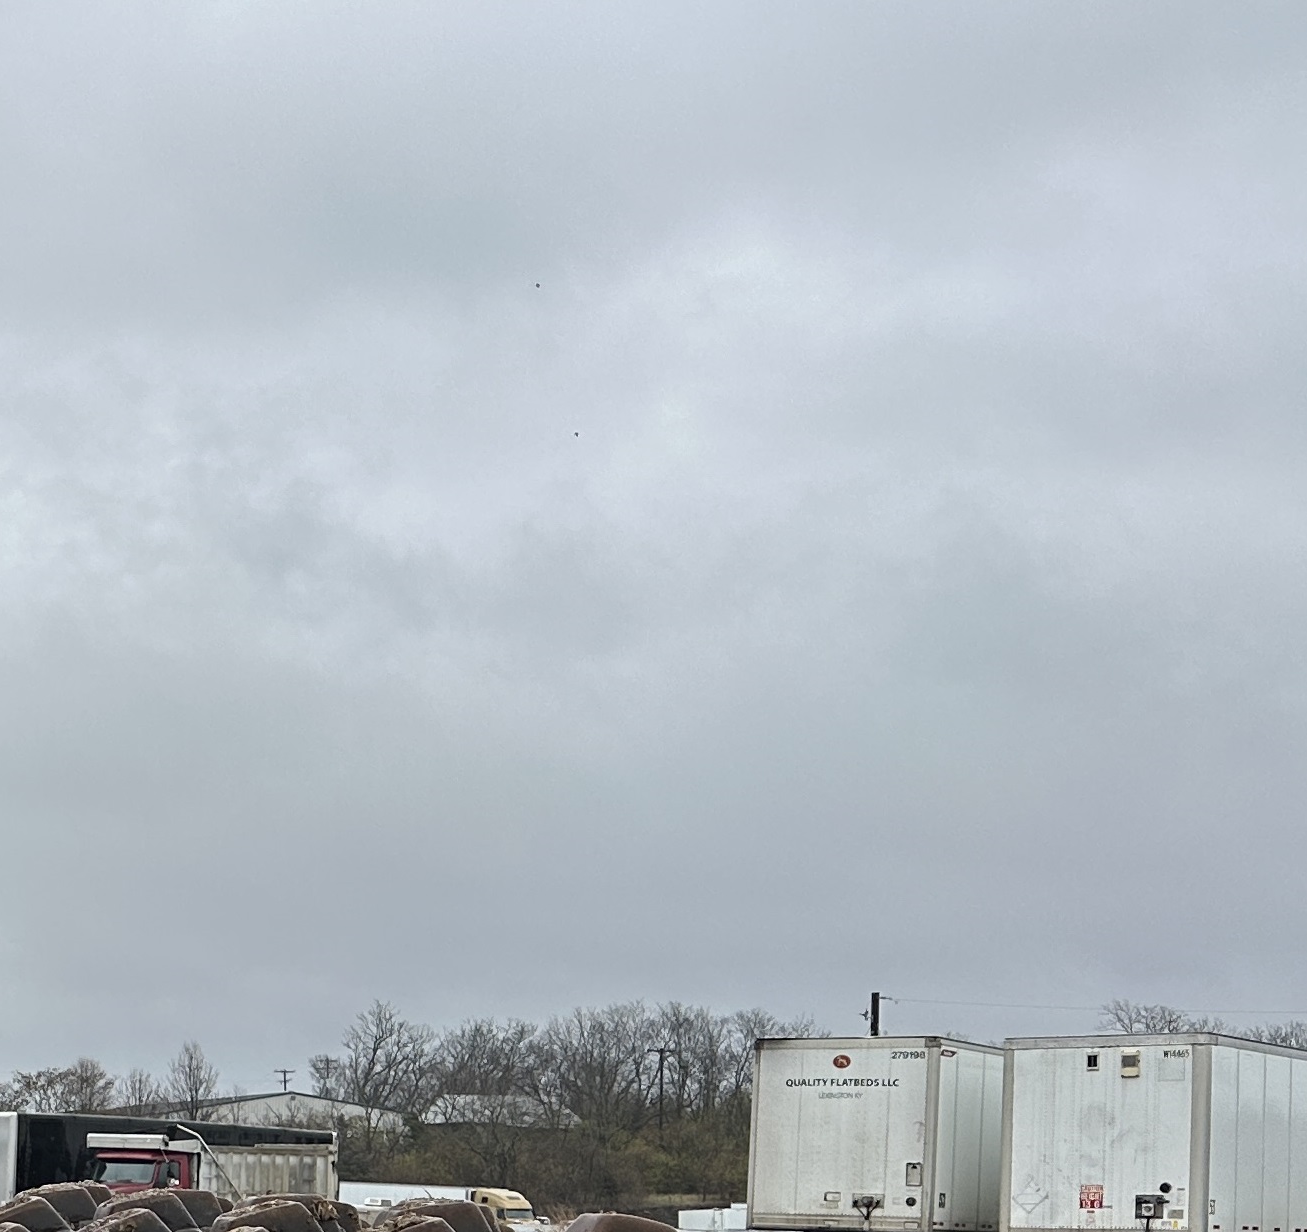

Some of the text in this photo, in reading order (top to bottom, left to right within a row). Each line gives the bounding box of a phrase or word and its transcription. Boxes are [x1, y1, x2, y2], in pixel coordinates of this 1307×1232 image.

[786, 1079, 900, 1087] QUALITY FLATBEDS LLC
